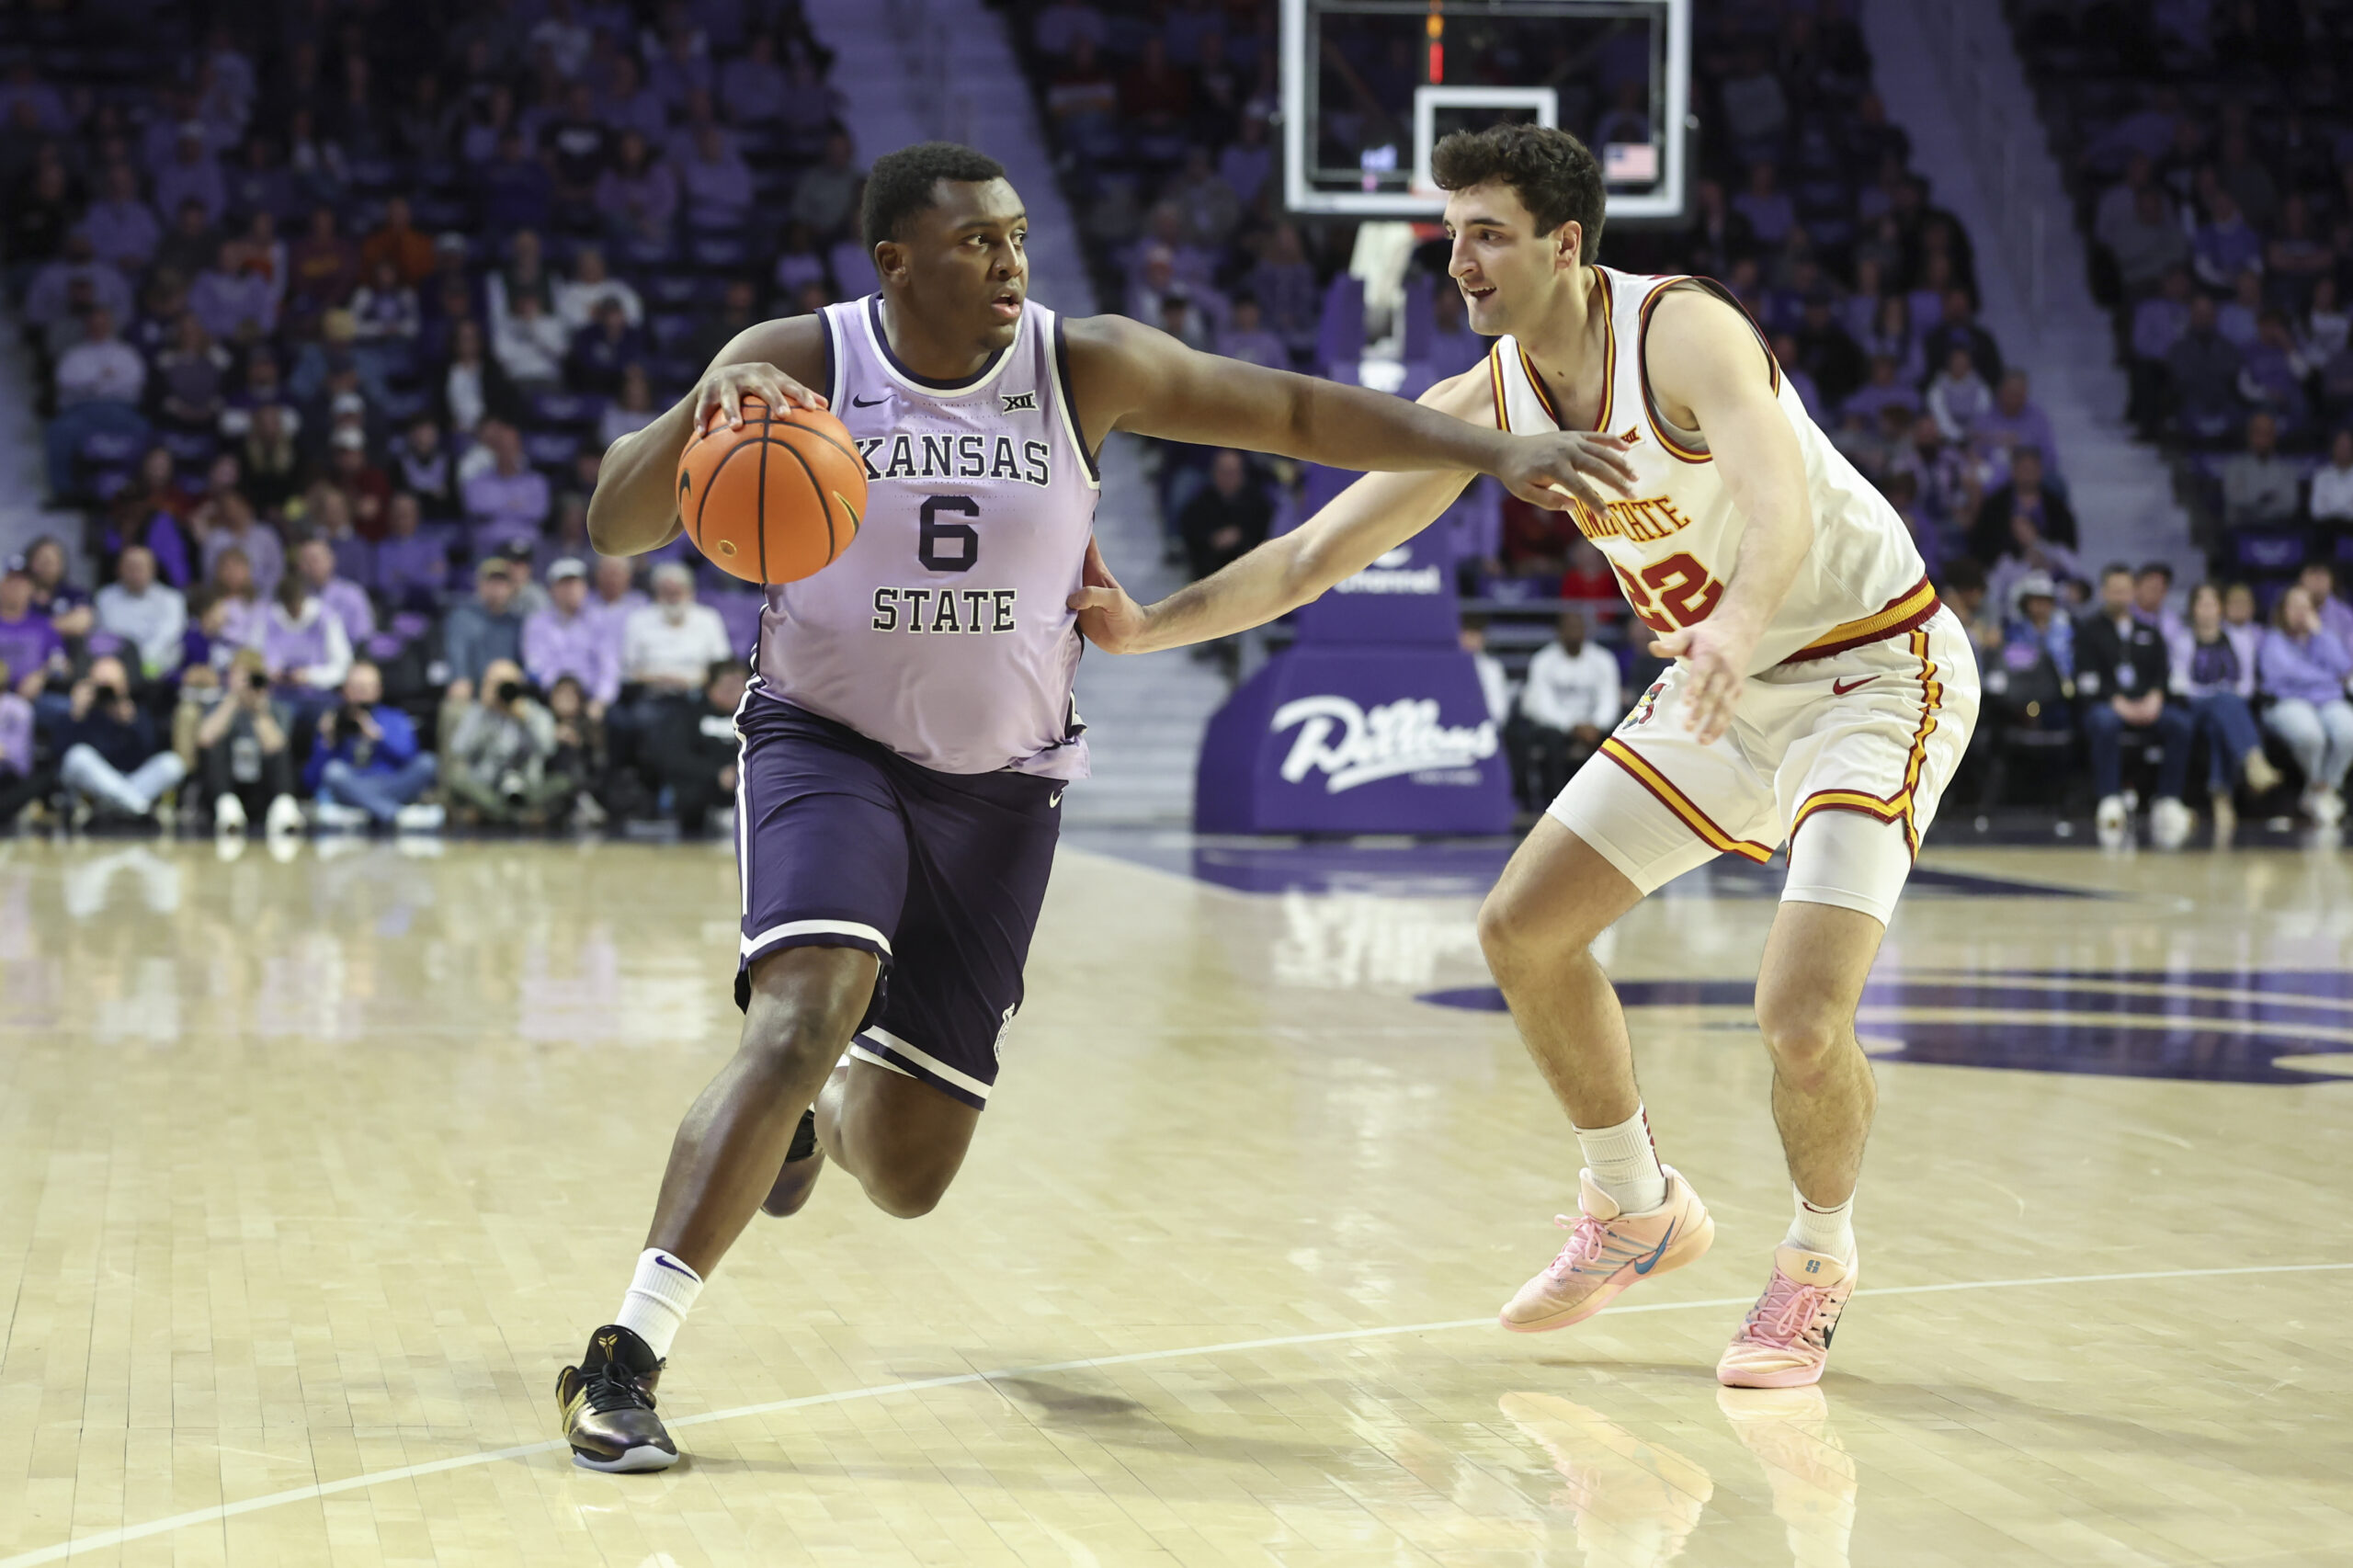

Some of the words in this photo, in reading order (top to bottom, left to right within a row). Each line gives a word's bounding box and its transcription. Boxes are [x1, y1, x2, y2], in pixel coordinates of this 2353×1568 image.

[1001, 392, 1038, 414] XII
[855, 434, 1050, 488] KANSAS
[918, 495, 980, 572] 6
[871, 586, 1017, 634] STATE
